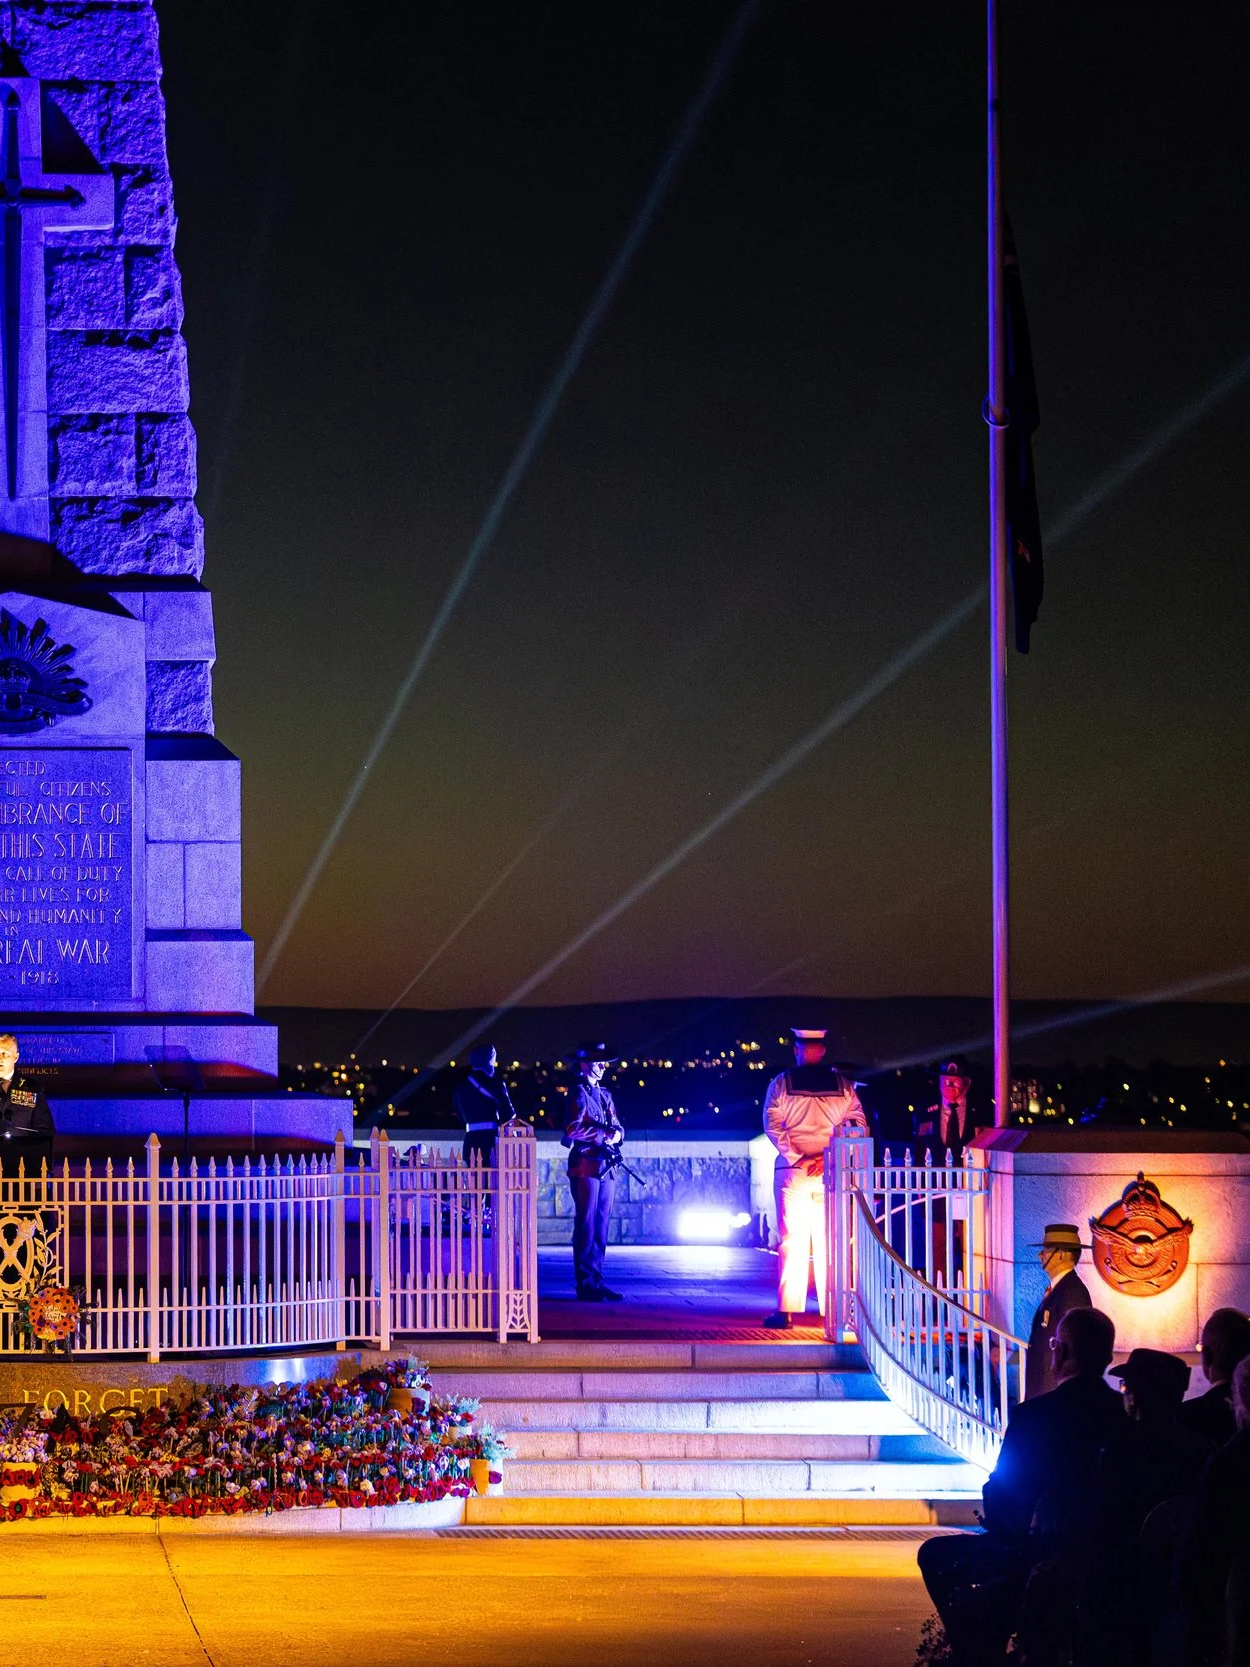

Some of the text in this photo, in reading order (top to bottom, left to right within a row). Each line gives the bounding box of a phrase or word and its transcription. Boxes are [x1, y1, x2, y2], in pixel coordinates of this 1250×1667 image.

[40, 782, 111, 797] CITIZENS
[101, 803, 128, 825] OF
[0, 832, 45, 859] THIS
[54, 832, 122, 859] STATE
[5, 866, 46, 882] CALL
[51, 866, 72, 882] OF
[77, 866, 123, 882] DUTY
[22, 887, 70, 903] LIVES
[76, 887, 110, 903] FOR
[28, 909, 123, 924] HUMANITY
[4, 926, 19, 936] IN
[56, 939, 110, 965] WAR
[21, 971, 60, 986] 1918
[23, 1387, 168, 1418] FORGET
